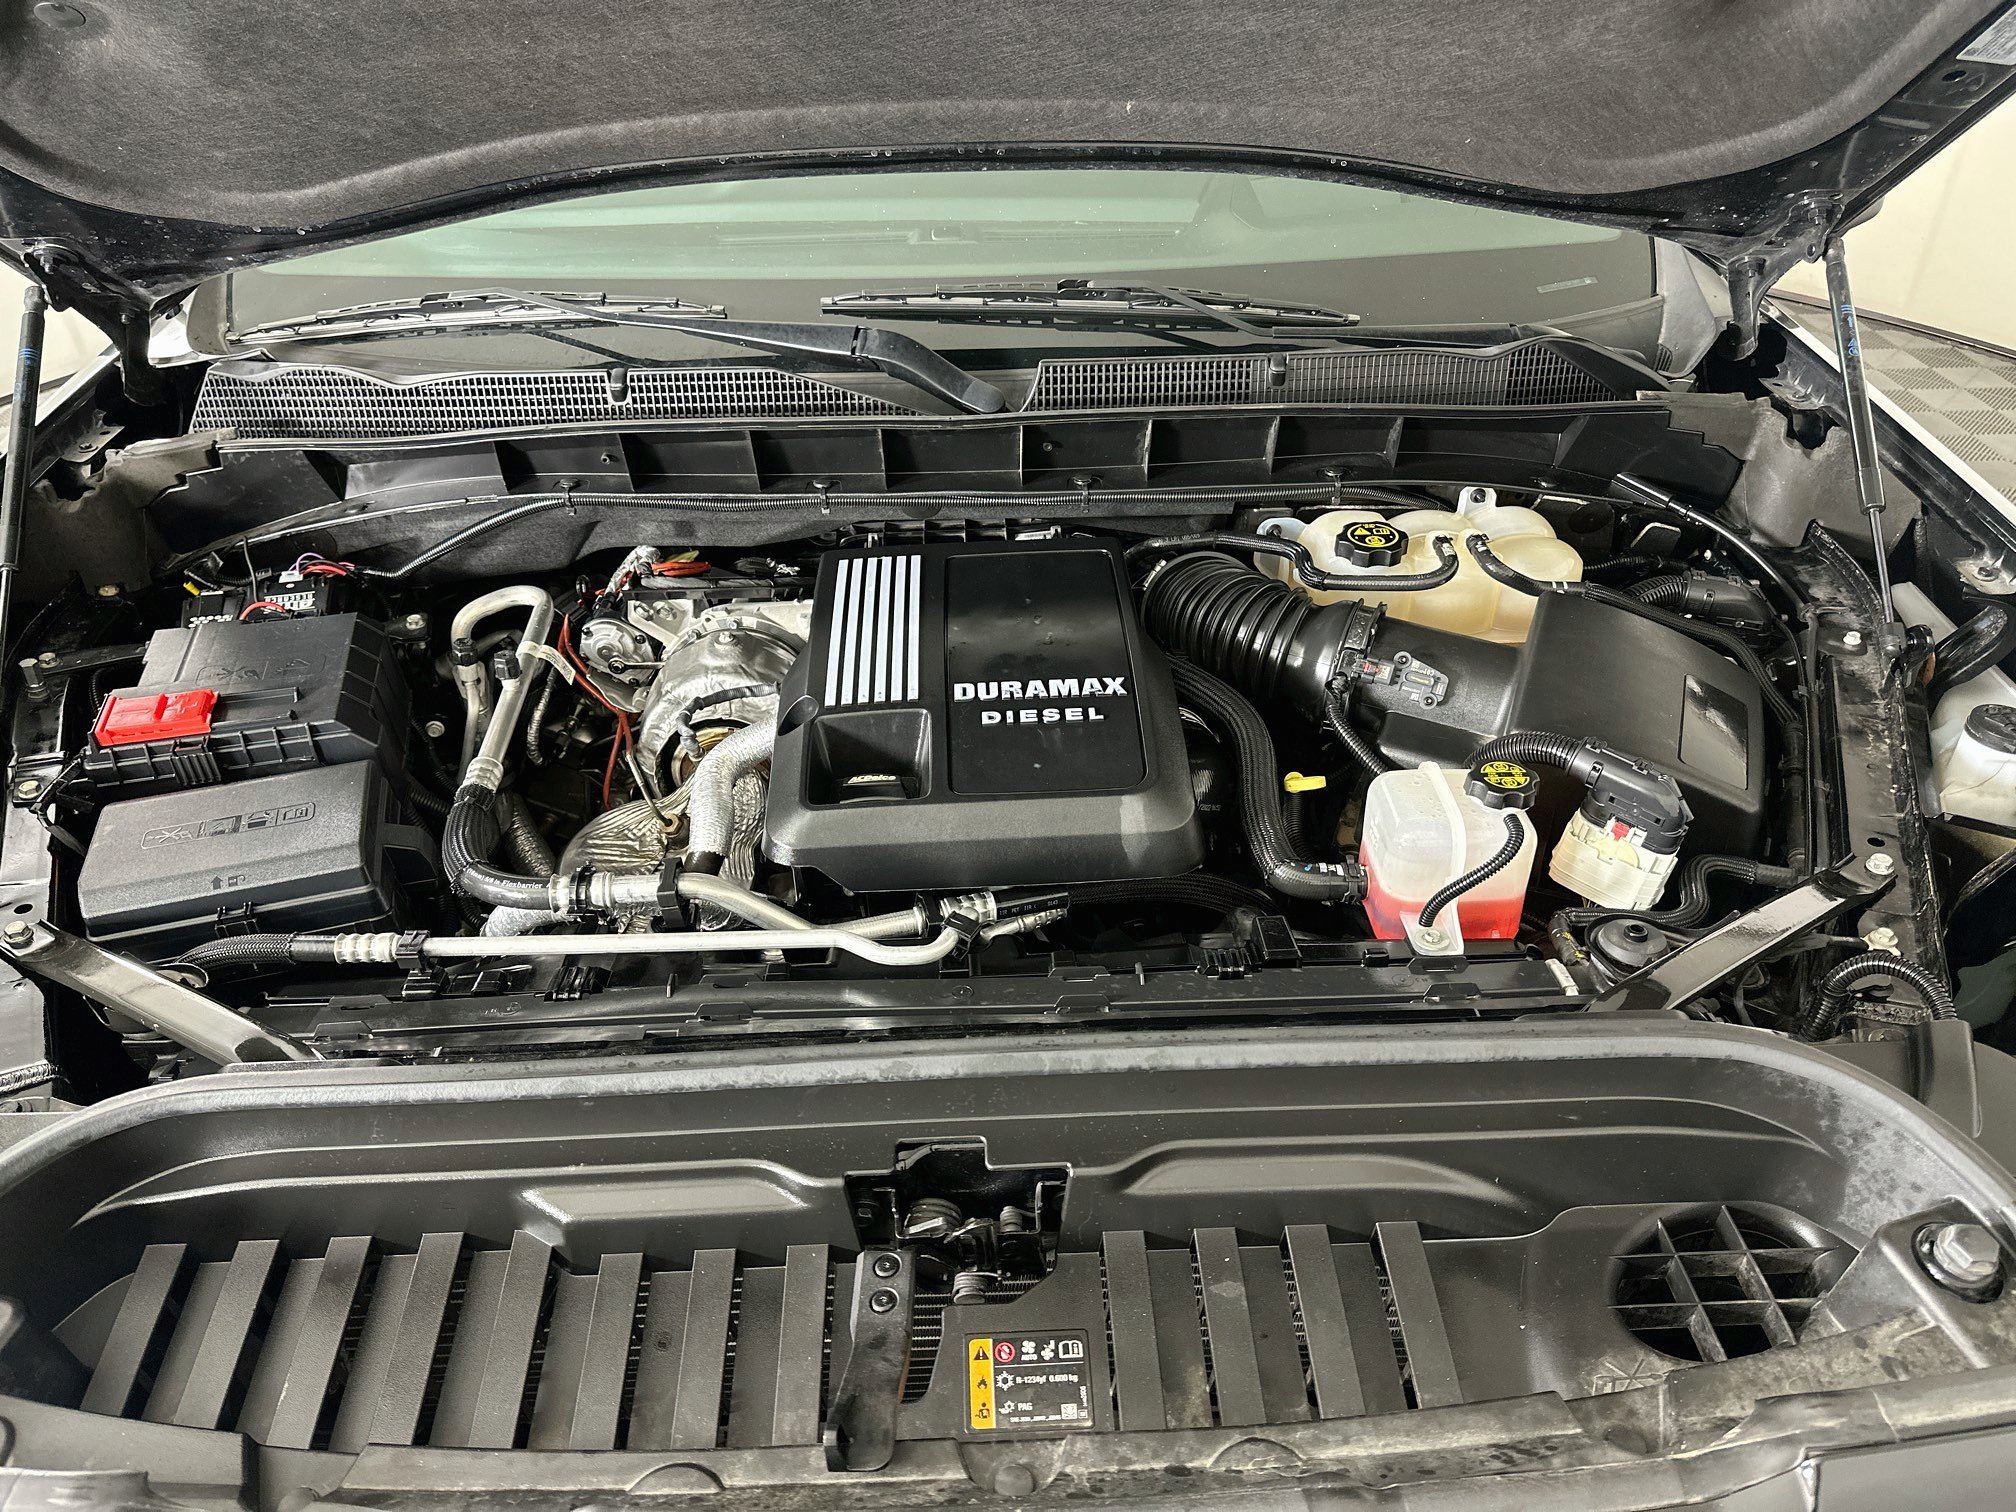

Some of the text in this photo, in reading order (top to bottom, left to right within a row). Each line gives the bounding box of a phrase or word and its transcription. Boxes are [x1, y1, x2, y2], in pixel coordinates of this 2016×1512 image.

[954, 676, 1128, 702] DURAMAX
[981, 707, 1105, 725] DIESEL
[501, 879, 543, 889] Flexbarrier
[1018, 1403, 1033, 1411] PAG
